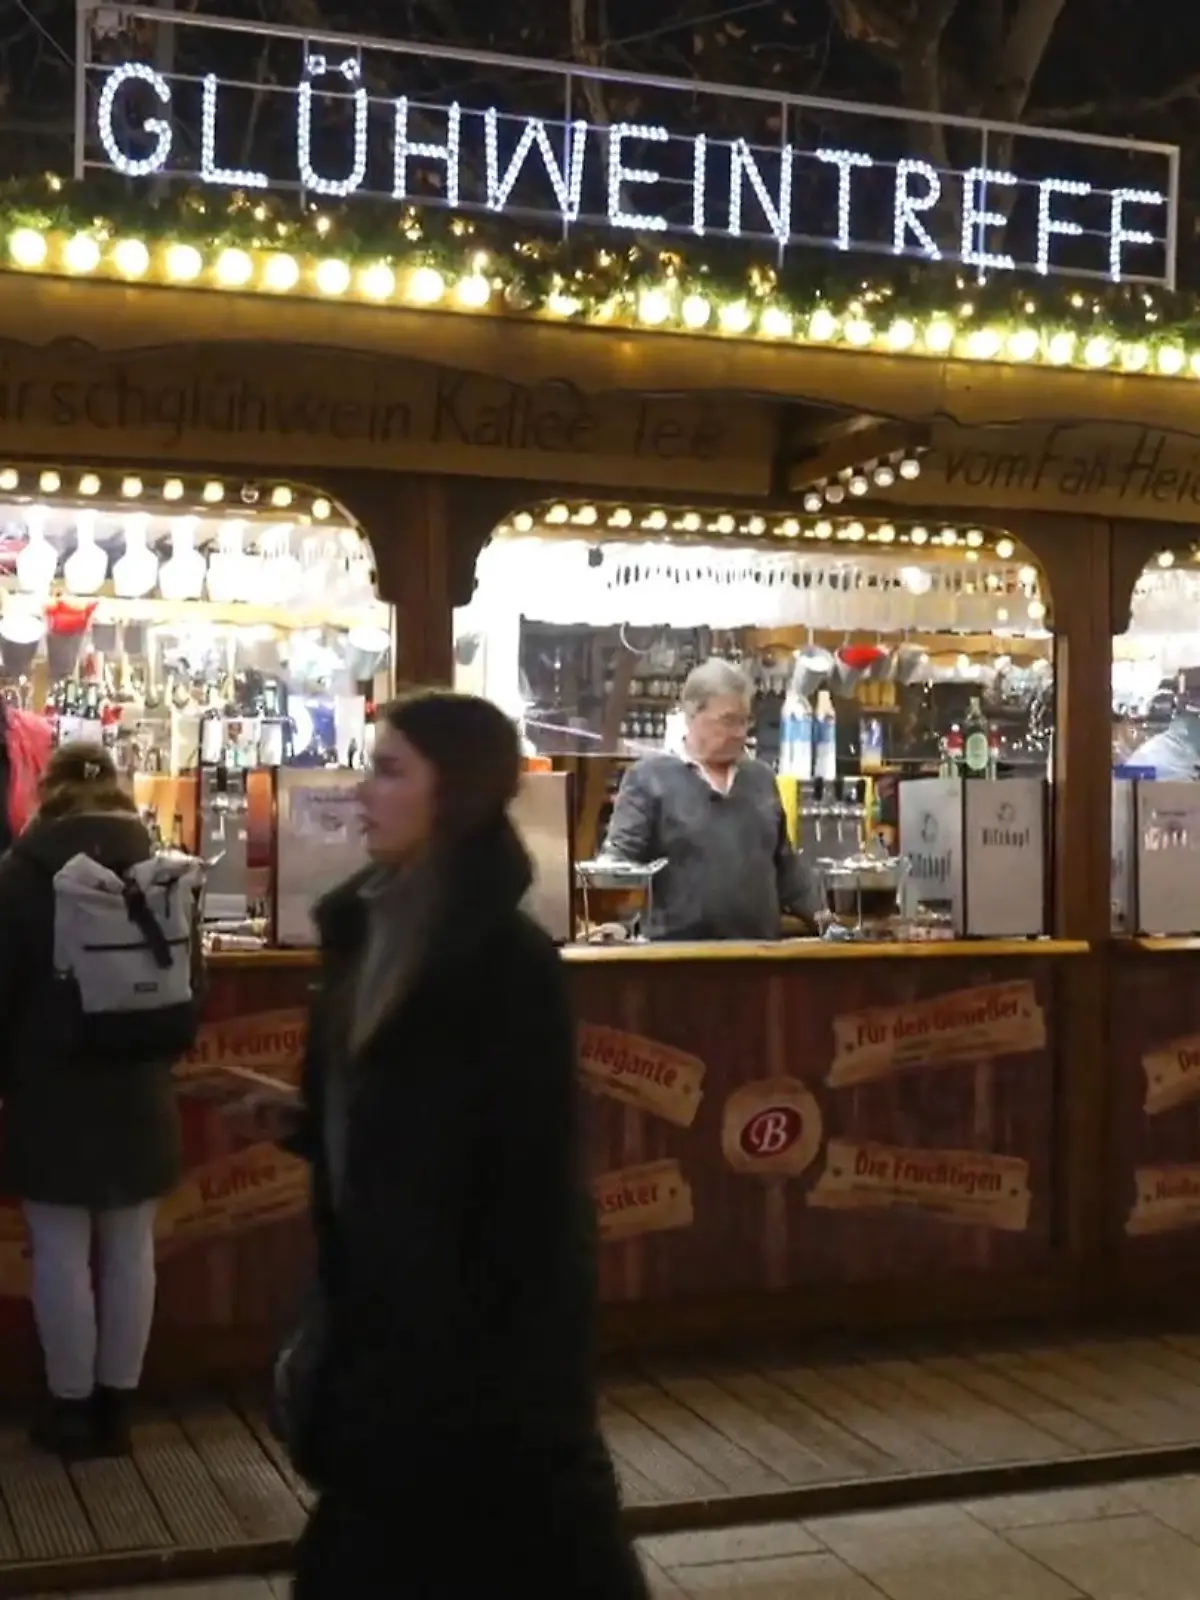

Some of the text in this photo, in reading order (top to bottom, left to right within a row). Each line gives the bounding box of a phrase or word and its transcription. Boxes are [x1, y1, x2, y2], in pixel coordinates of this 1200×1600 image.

[98, 54, 1164, 282] GLÜHWEINTREFF
[945, 450, 1030, 489] vom
[750, 1110, 789, 1152] B
[854, 1149, 889, 1179] Die
